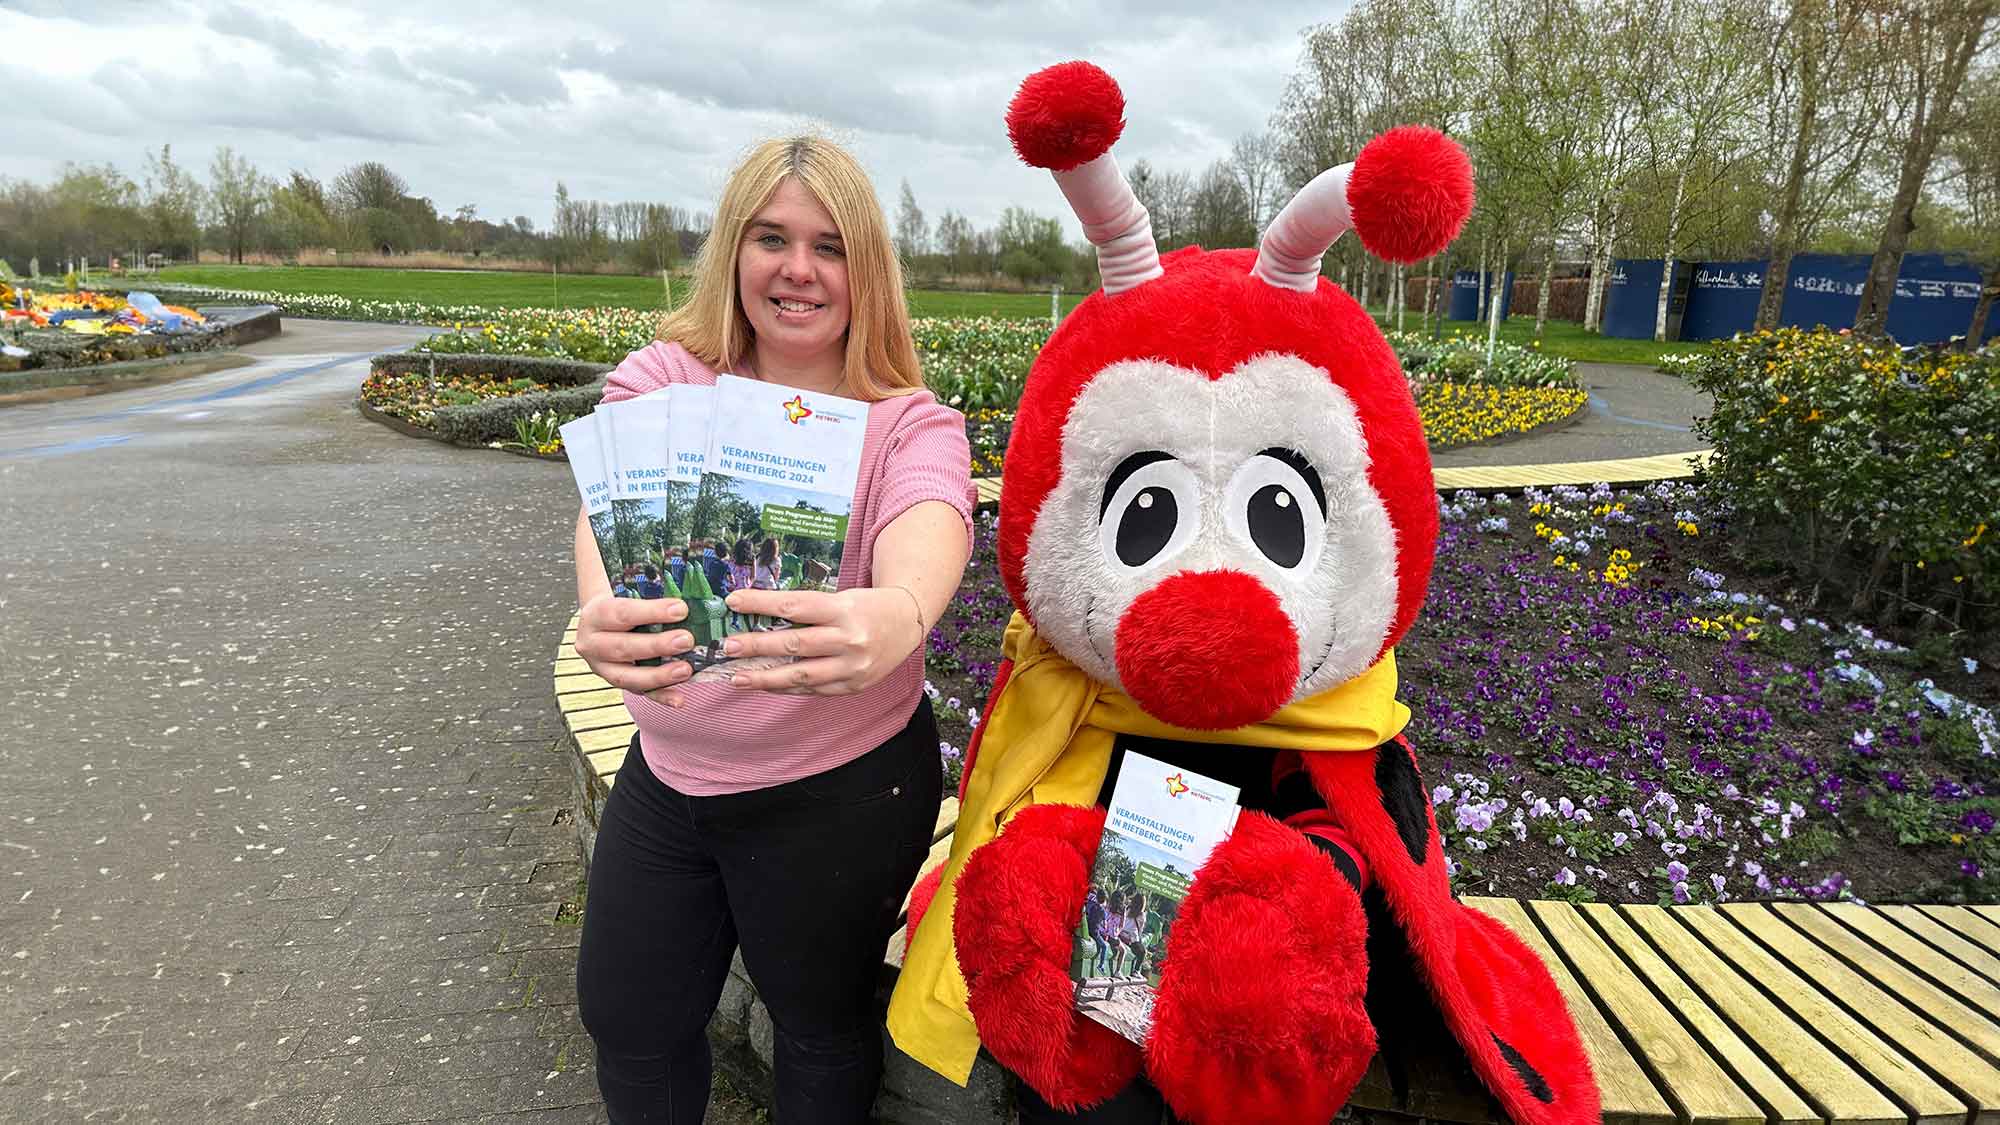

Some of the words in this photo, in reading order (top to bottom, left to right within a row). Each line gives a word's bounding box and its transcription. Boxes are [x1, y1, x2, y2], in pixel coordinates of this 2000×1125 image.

[722, 445, 827, 473] VERANSTALTUNGEN
[625, 467, 668, 480] VERANS
[677, 465, 688, 476] IN
[720, 458, 732, 469] IN
[735, 462, 786, 480] RIETBERG
[788, 471, 815, 484] 2024
[627, 482, 638, 493] IN
[590, 496, 601, 508] IN
[1112, 817, 1121, 828] IN
[1122, 821, 1161, 843] RIETBERG
[1162, 838, 1184, 851] 2024
[1115, 806, 1195, 844] VERANSTALTUNGEN
